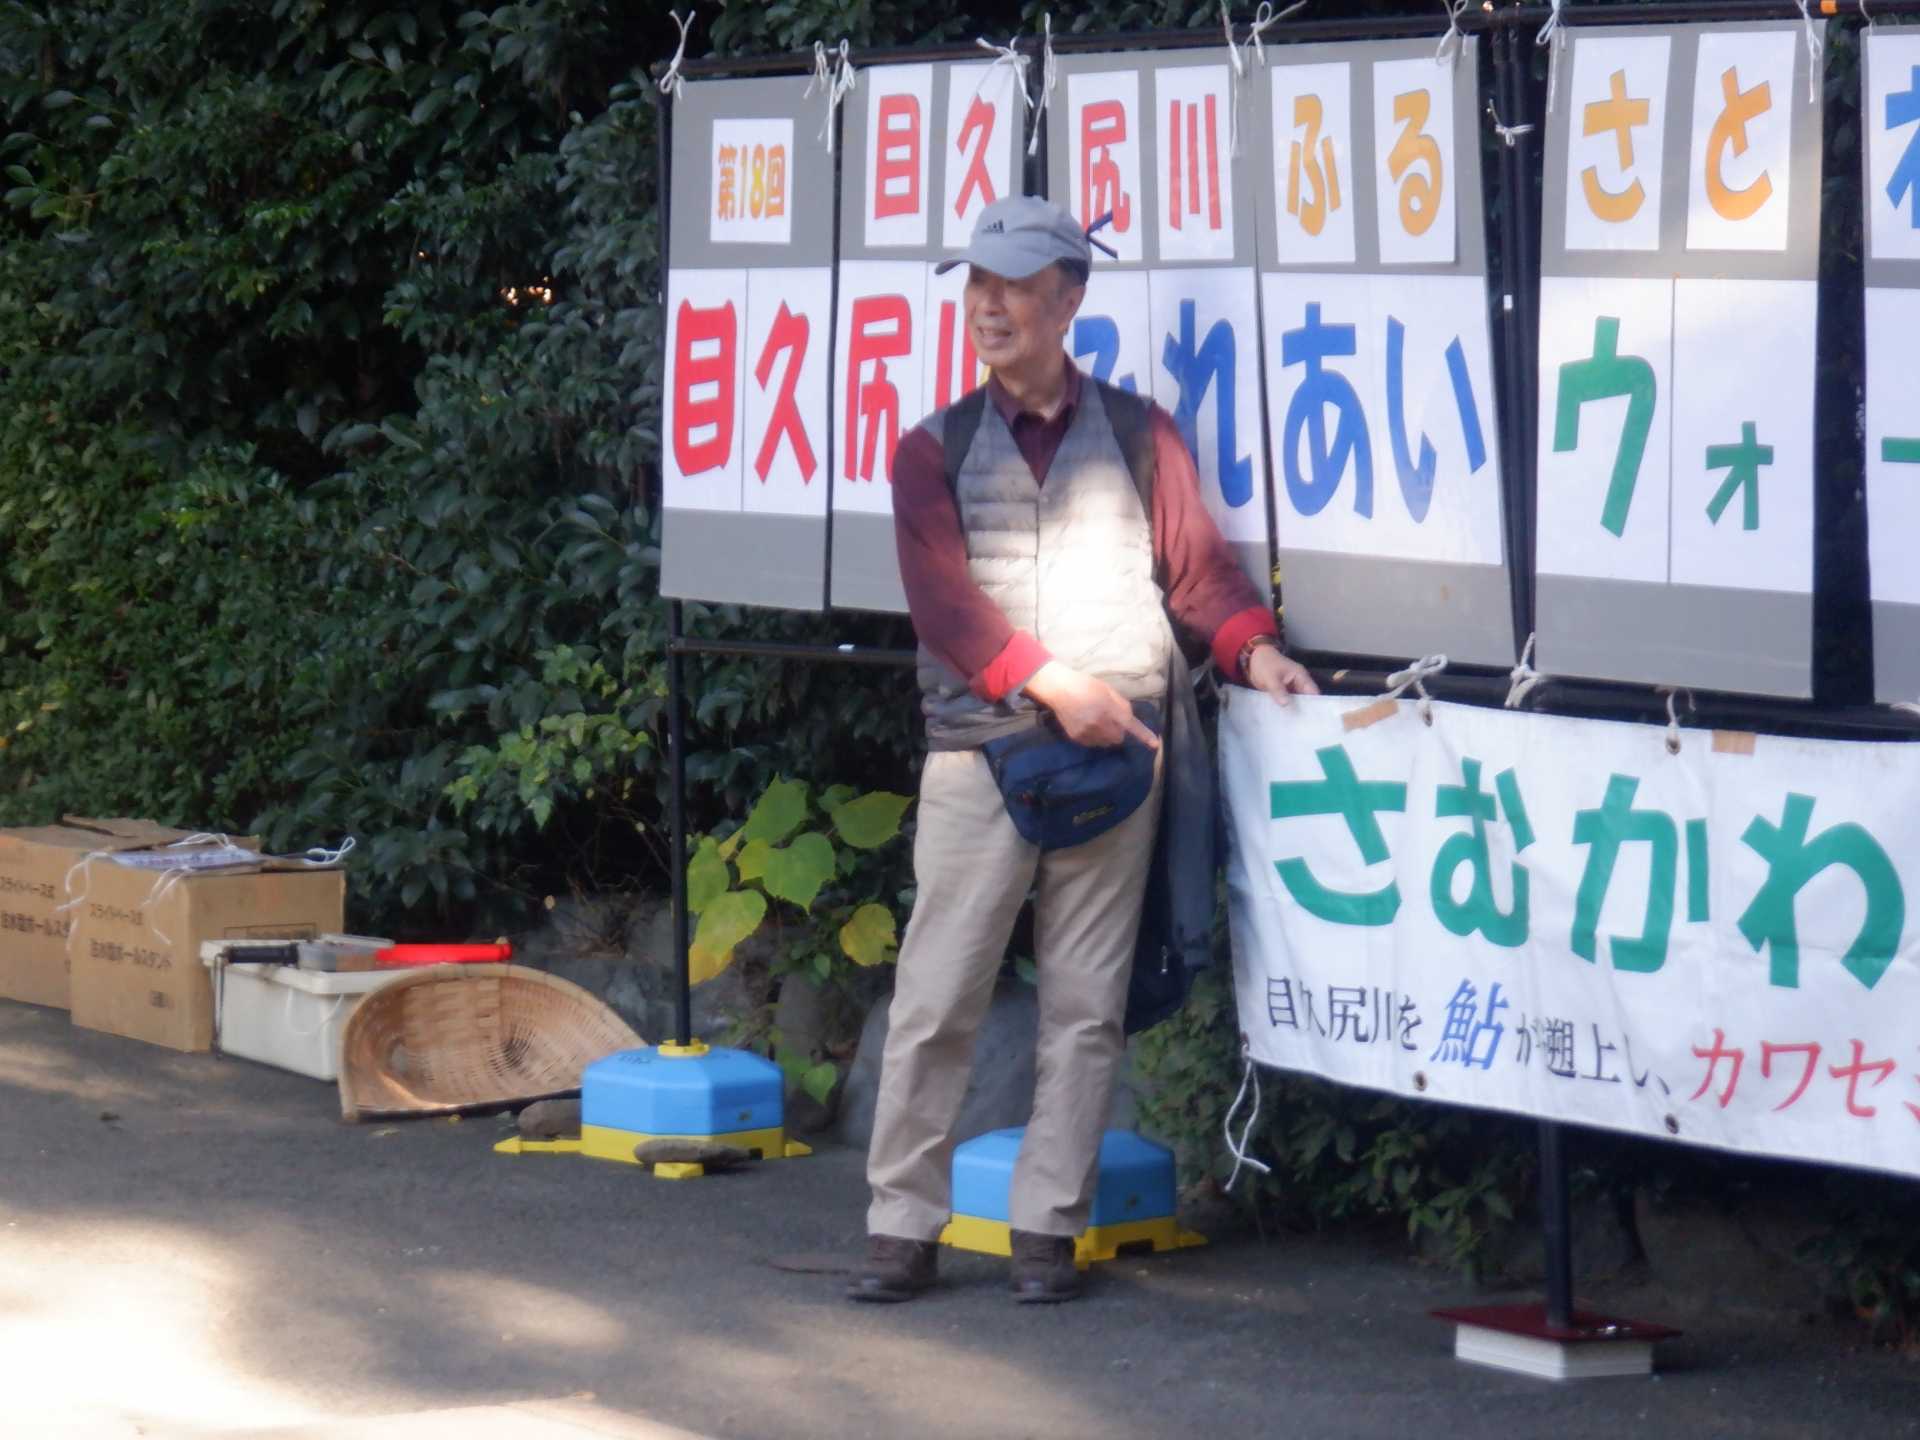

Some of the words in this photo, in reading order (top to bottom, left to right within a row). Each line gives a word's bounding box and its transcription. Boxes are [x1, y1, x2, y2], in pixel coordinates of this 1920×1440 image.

[717, 143, 786, 222] 第18回
[1269, 743, 1906, 990] さむかわ
